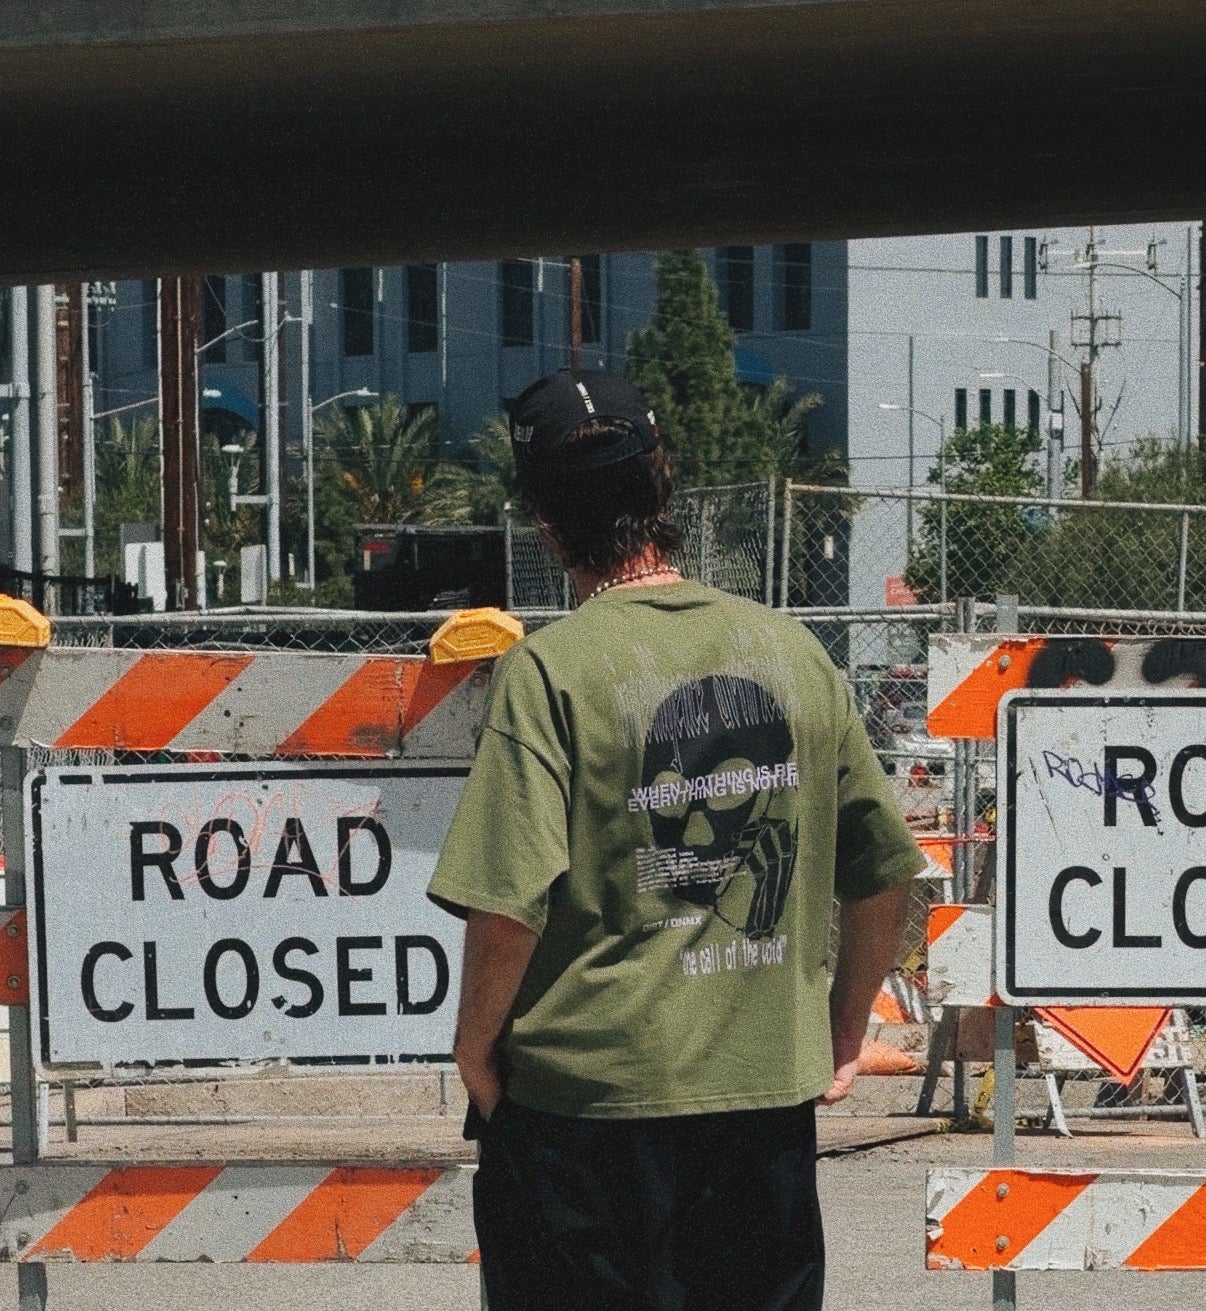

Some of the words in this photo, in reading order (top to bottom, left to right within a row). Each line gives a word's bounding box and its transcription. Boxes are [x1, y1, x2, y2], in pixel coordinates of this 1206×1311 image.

[628, 782, 727, 812] EVERYTHING
[731, 779, 747, 795] IS
[631, 781, 680, 801] WHEN
[684, 767, 753, 794] NOTHING
[755, 764, 770, 779] IS
[1104, 744, 1206, 827] RO
[130, 816, 392, 901] ROAD
[1048, 865, 1206, 949] CLO
[80, 934, 450, 1023] CLOSED
[725, 940, 737, 970] of
[743, 937, 758, 967] the
